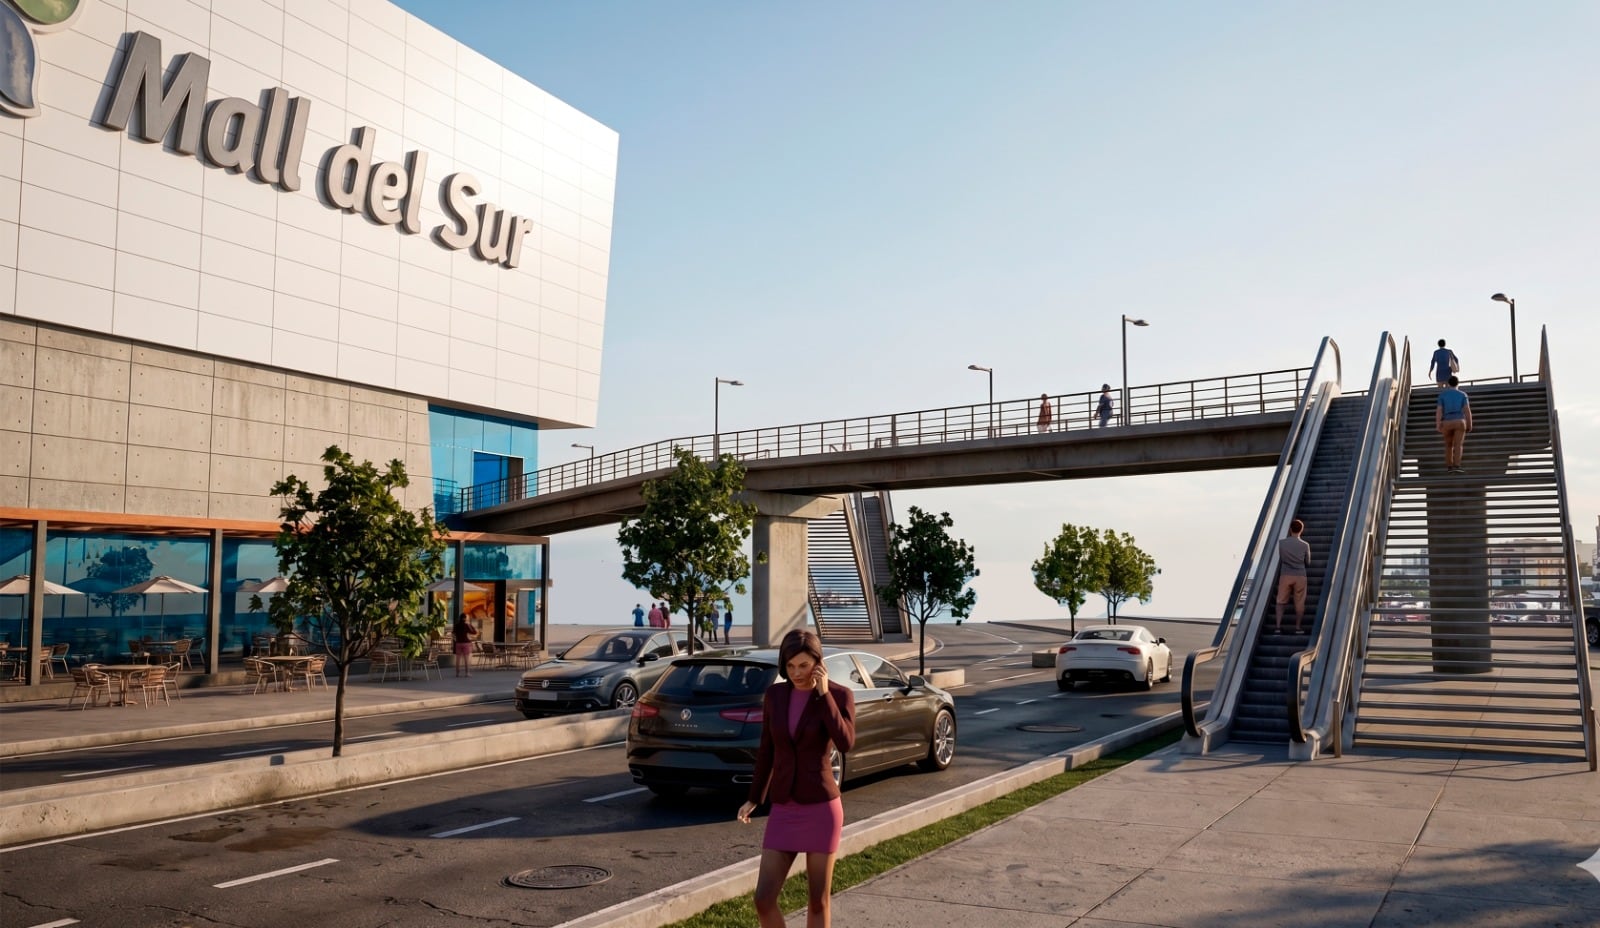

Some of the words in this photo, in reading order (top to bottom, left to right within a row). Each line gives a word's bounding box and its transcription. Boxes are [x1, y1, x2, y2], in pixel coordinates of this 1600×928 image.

[104, 30, 311, 192] Mall
[324, 126, 428, 234] del
[438, 172, 533, 269] Sur
